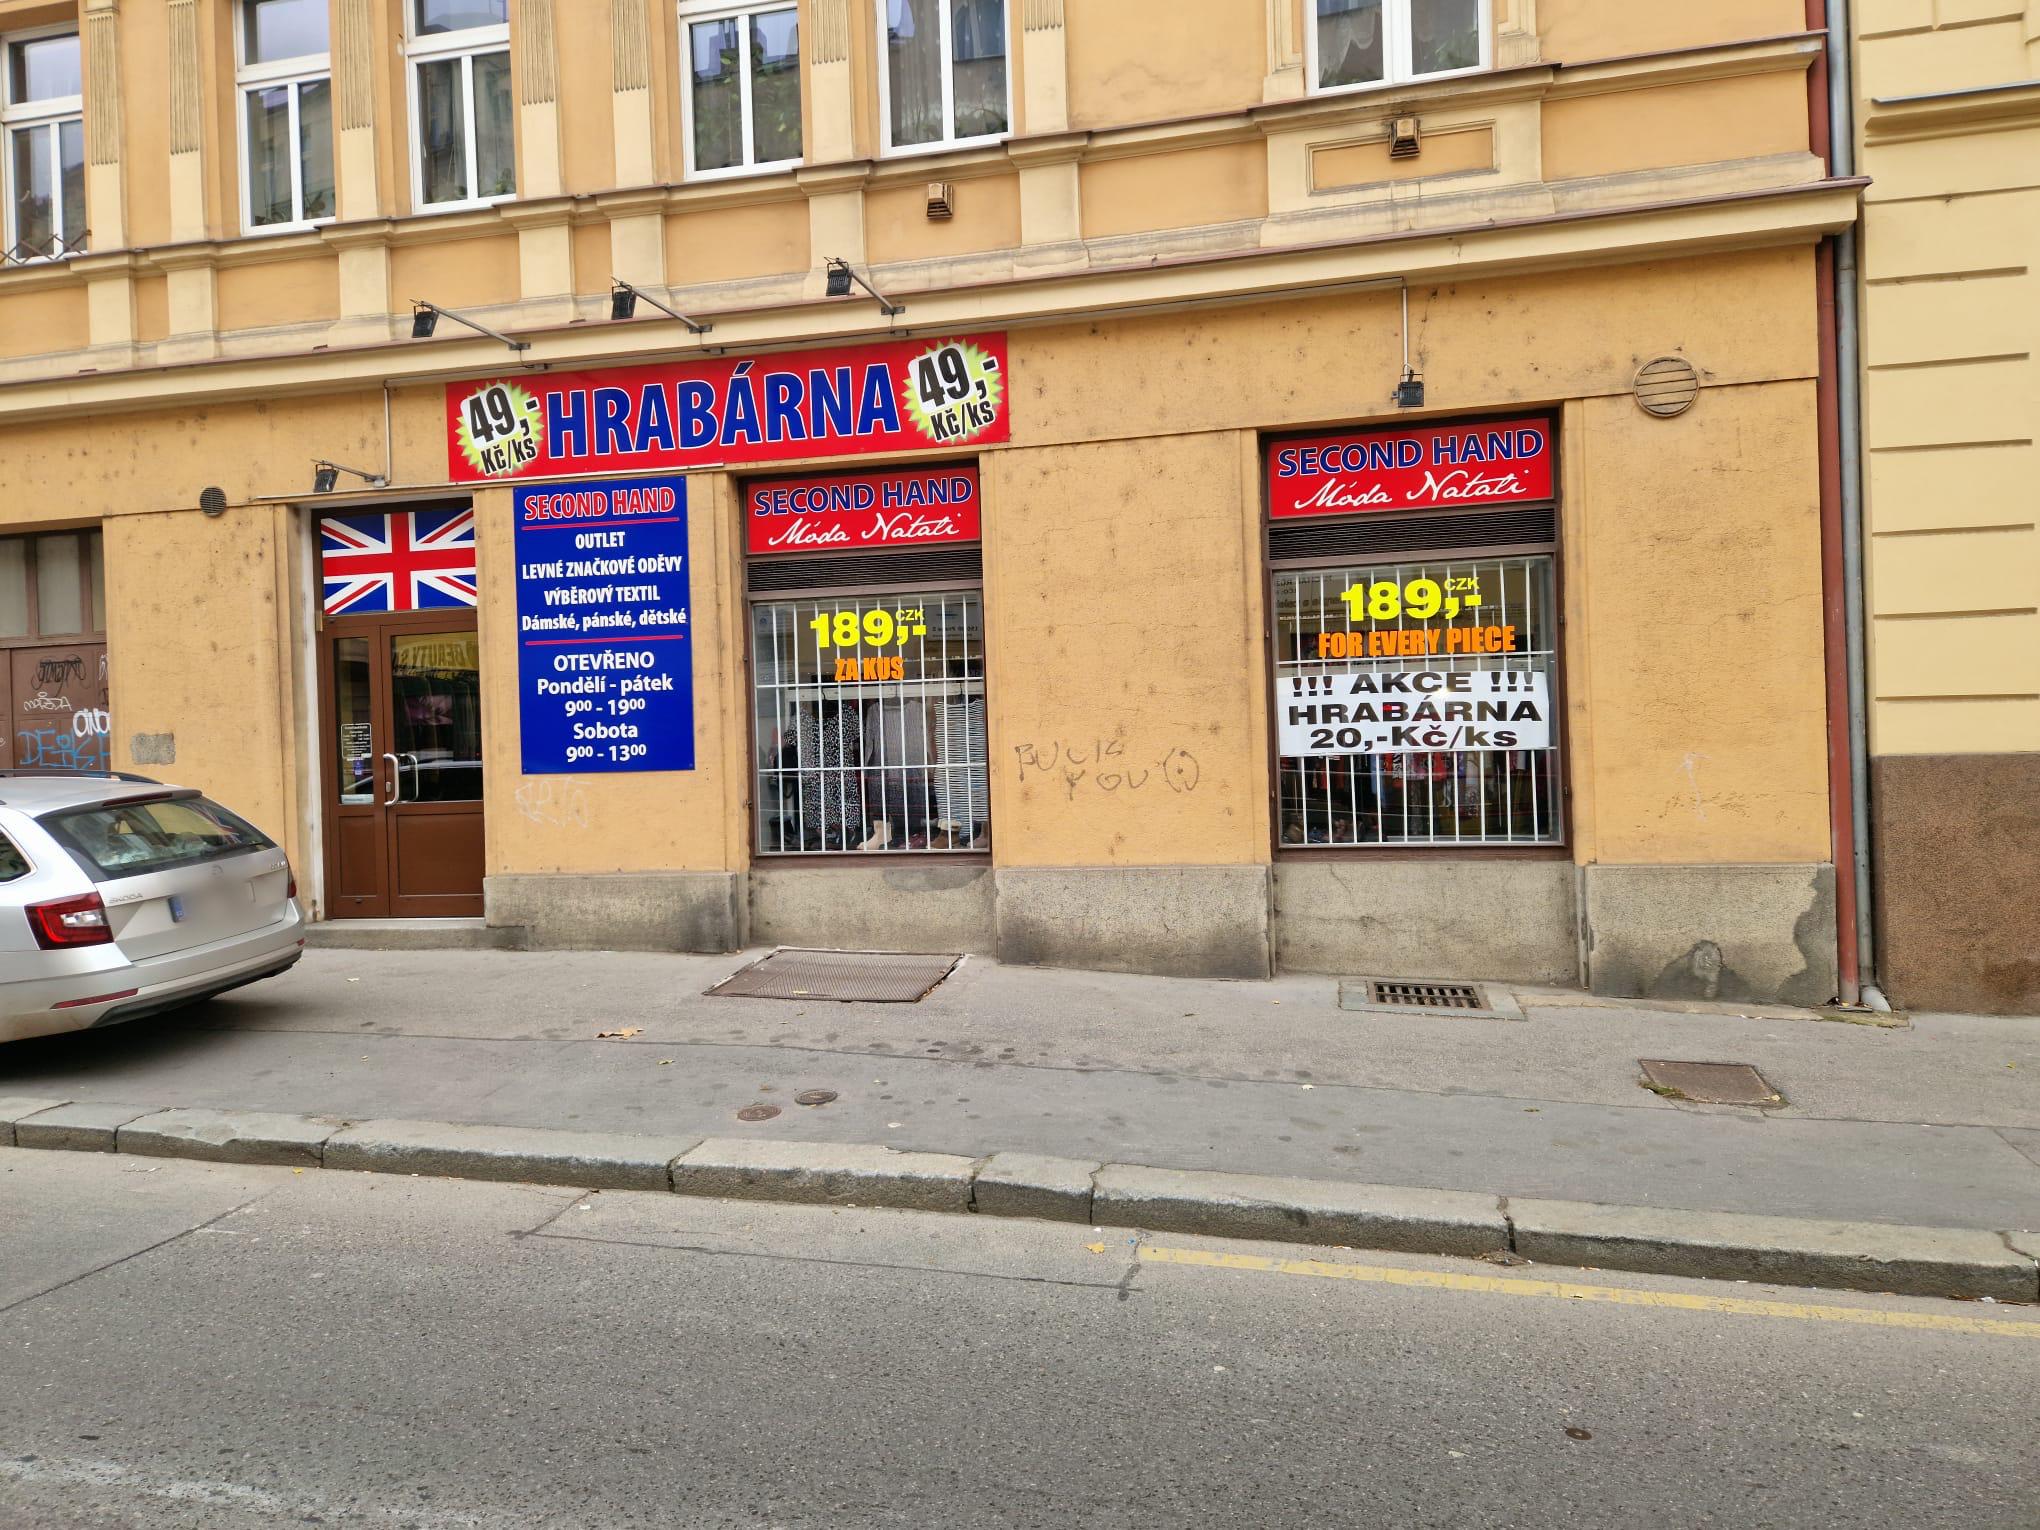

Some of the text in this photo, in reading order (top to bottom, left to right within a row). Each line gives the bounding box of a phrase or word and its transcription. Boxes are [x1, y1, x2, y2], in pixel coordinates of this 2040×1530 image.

[918, 347, 997, 408] 49,-
[469, 387, 538, 443] 49,-
[547, 361, 901, 459] HRABÁRNA
[930, 400, 995, 441] Kč/ks
[480, 437, 537, 475] Kč/ks
[1278, 429, 1543, 478] SECOND HAND
[524, 486, 676, 521] SECOND HAND
[754, 476, 972, 517] SECOND HAND
[1294, 477, 1393, 509] Móda
[575, 531, 626, 549] OUTLET
[768, 517, 851, 546] Móda
[522, 554, 683, 580] LEVNÉ ZNAČKOVÉ ODĚVY
[544, 585, 661, 606] VÝBĚROVÝ TEXTIL
[1341, 579, 1482, 622] 189,-
[1443, 577, 1480, 591] CZK
[522, 608, 687, 632] Dámské, pánské, dětské
[810, 608, 927, 648] 189,- CZK
[1318, 626, 1516, 658] FOR EVERY PIECE
[553, 649, 655, 672] OTEVŘENO
[834, 656, 905, 681] ZA KUS
[537, 675, 606, 695] Pondělí
[620, 673, 674, 696] pátek
[1292, 672, 1534, 697] !!! AKCE !!!
[1289, 695, 1542, 726] HRABÁRNA
[573, 721, 638, 740] Sobota
[1310, 725, 1518, 751] 20,-Kč/ks
[1066, 766, 1148, 801] YOU
